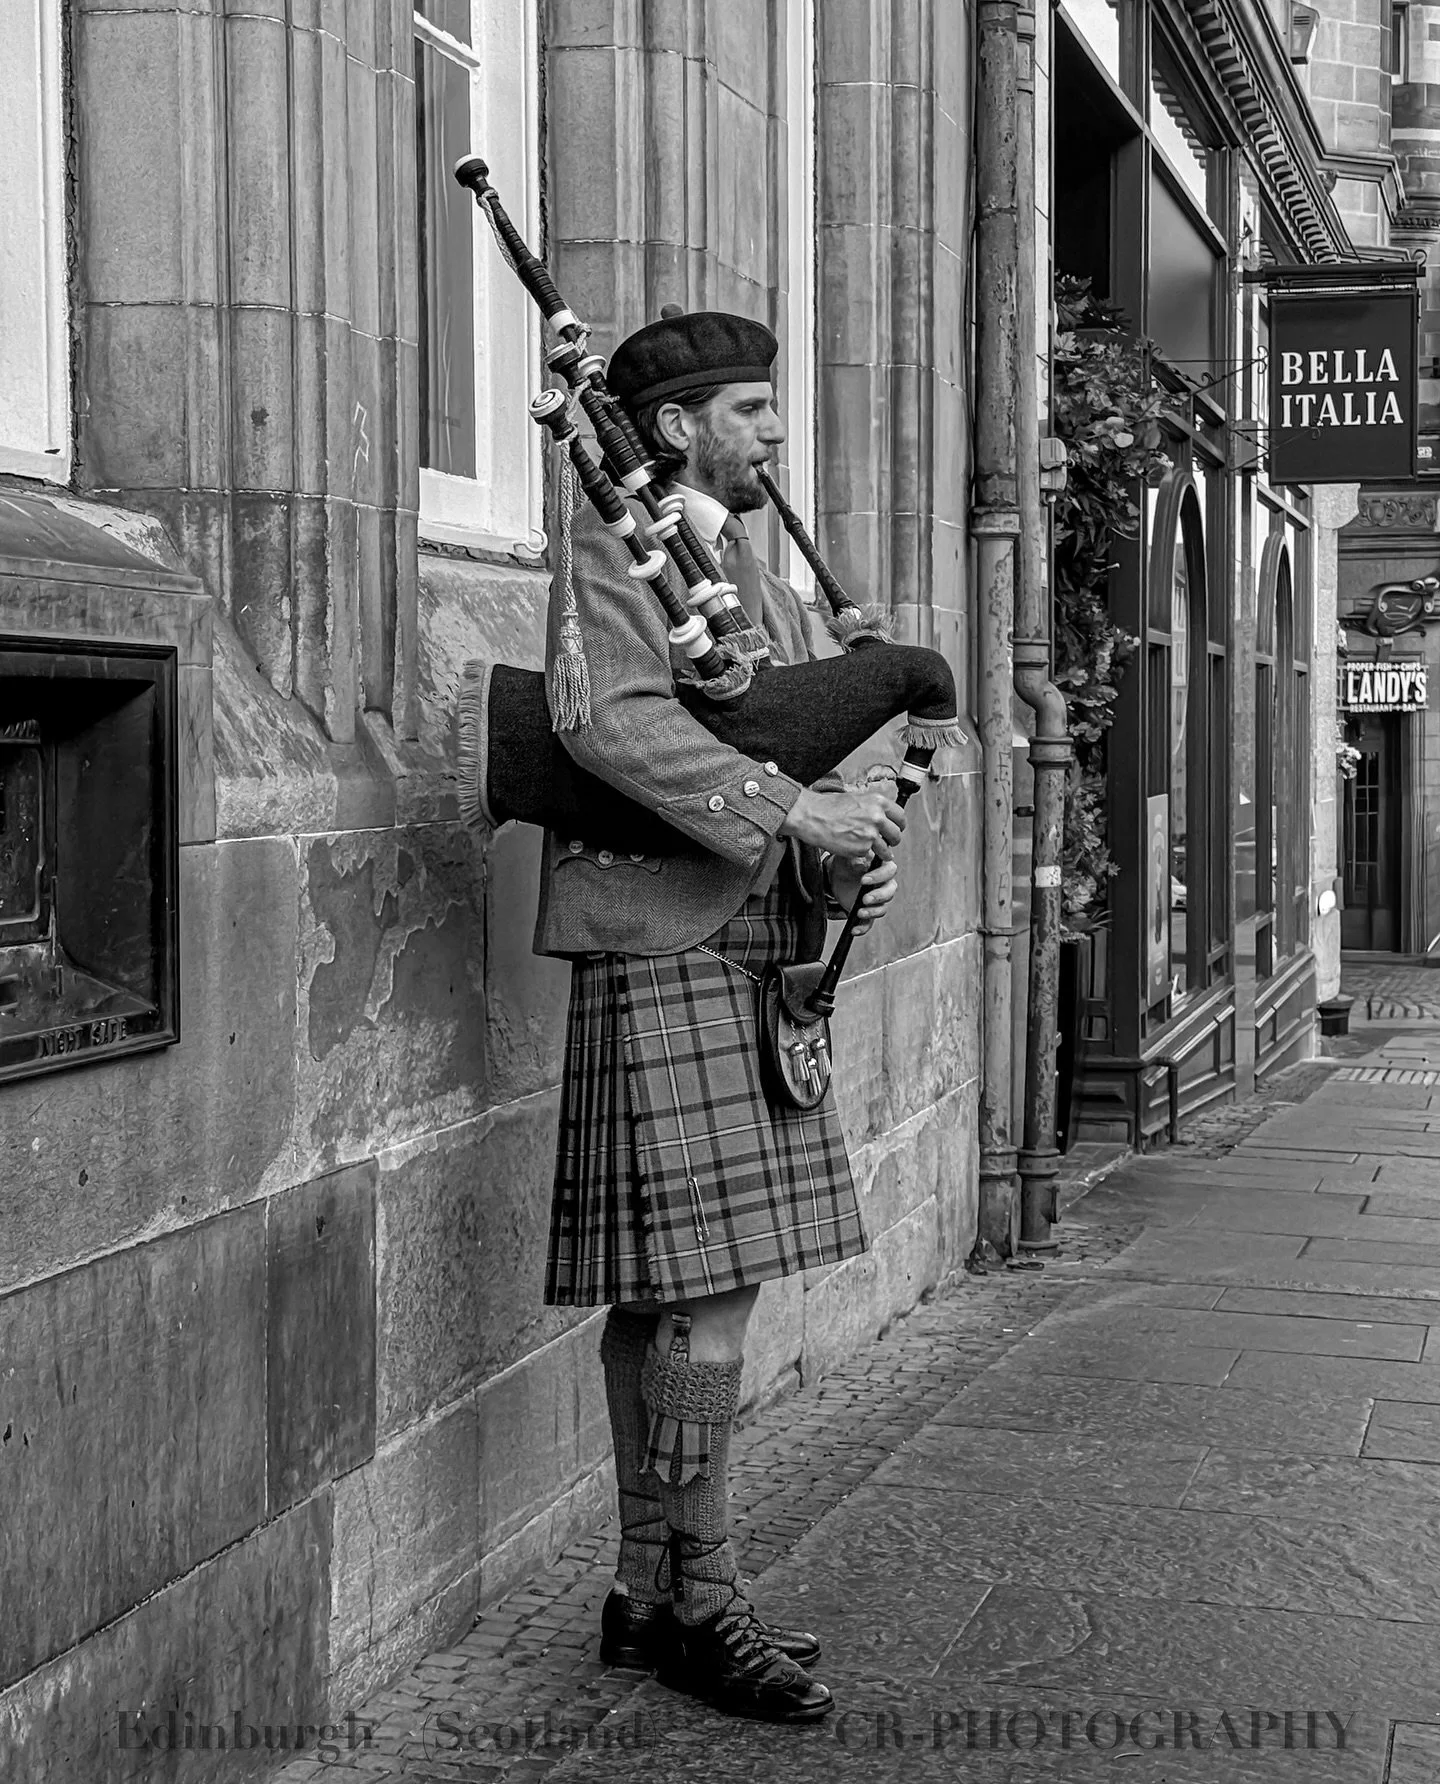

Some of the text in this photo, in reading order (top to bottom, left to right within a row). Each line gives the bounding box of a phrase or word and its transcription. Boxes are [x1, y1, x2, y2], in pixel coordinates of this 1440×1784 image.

[1281, 348, 1400, 386] BELLA
[1281, 391, 1404, 428] ITALIA
[1347, 662, 1375, 671] PROPER
[1376, 662, 1392, 671] FISH
[1401, 662, 1421, 671] CHIPS
[1347, 671, 1427, 703] LANDY'S
[1350, 703, 1393, 712] RESTAURANT
[1402, 703, 1417, 712] BAR
[90, 1016, 127, 1046] SAFE
